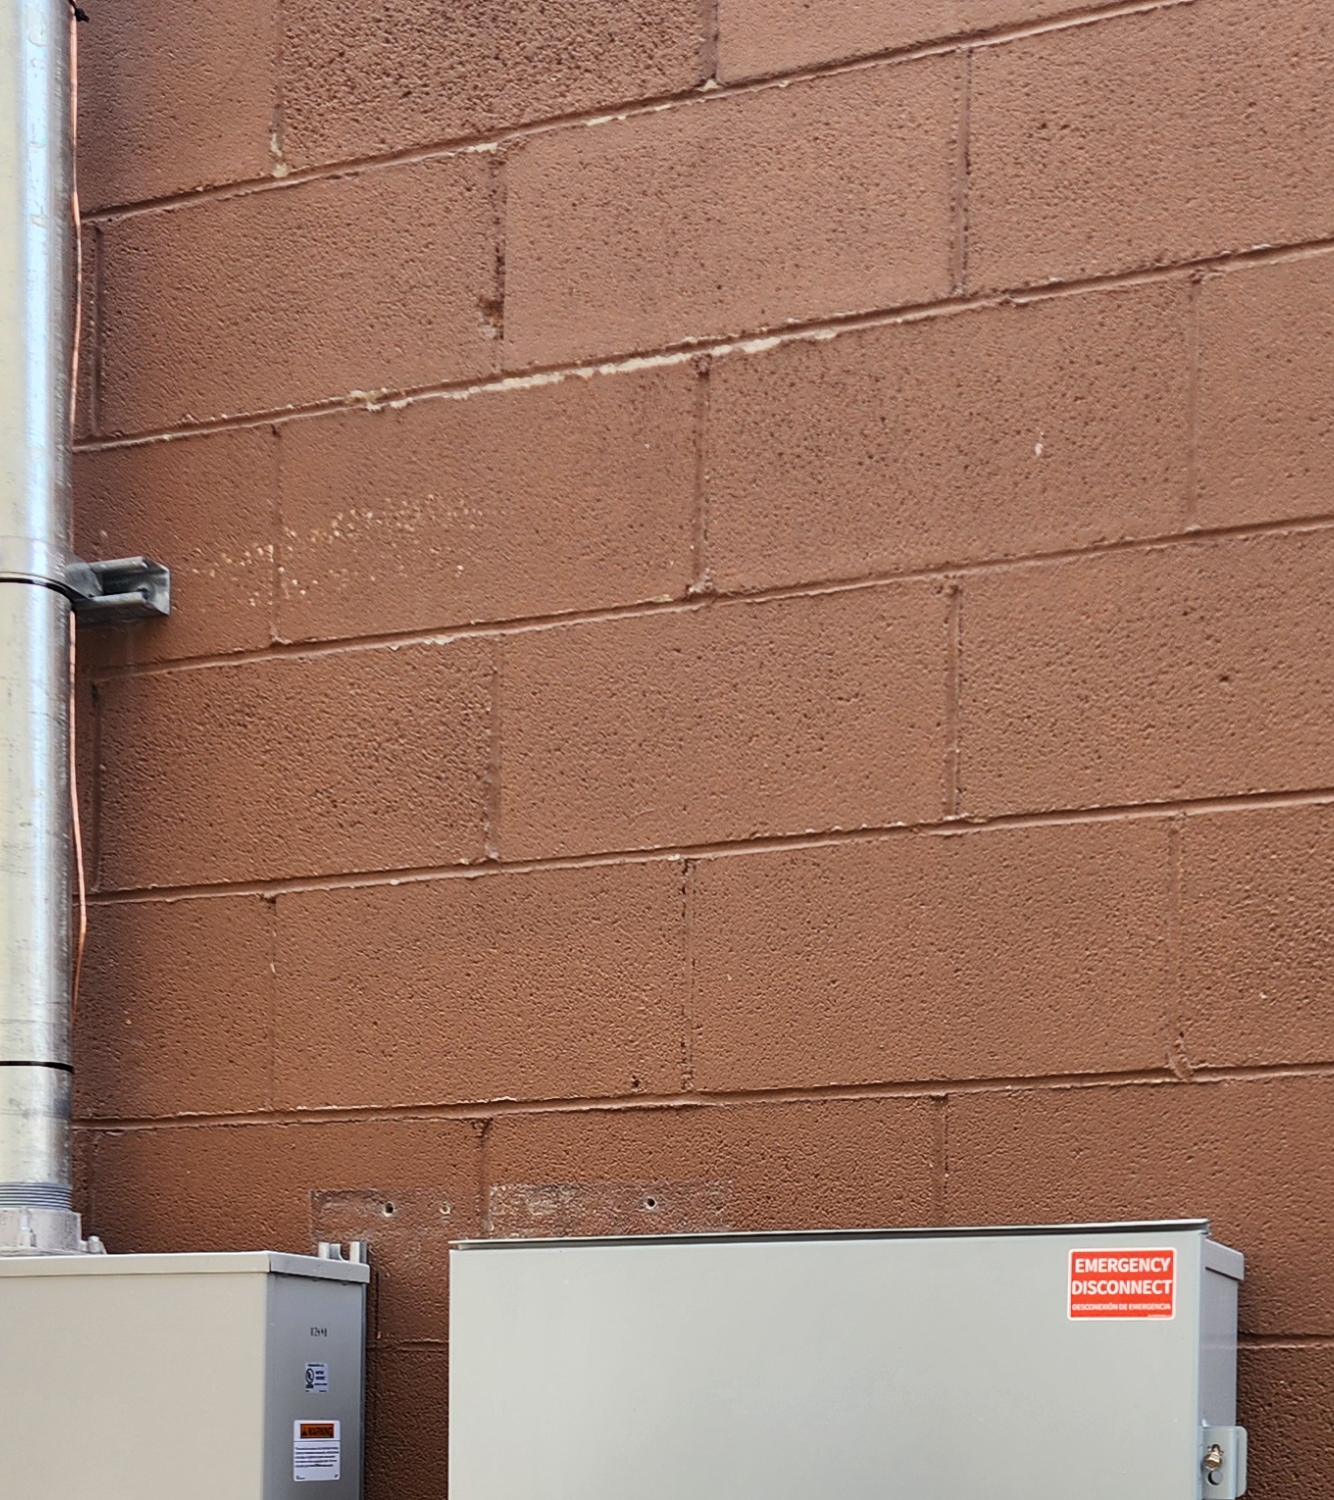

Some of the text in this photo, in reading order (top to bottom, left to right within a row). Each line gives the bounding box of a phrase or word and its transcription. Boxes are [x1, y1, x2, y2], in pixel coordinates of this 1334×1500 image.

[1075, 1257, 1171, 1273] EMERGENCY
[1071, 1280, 1173, 1295] DISCONNECT
[1119, 1303, 1127, 1311] DE
[1129, 1303, 1171, 1311] EMERGENCIA
